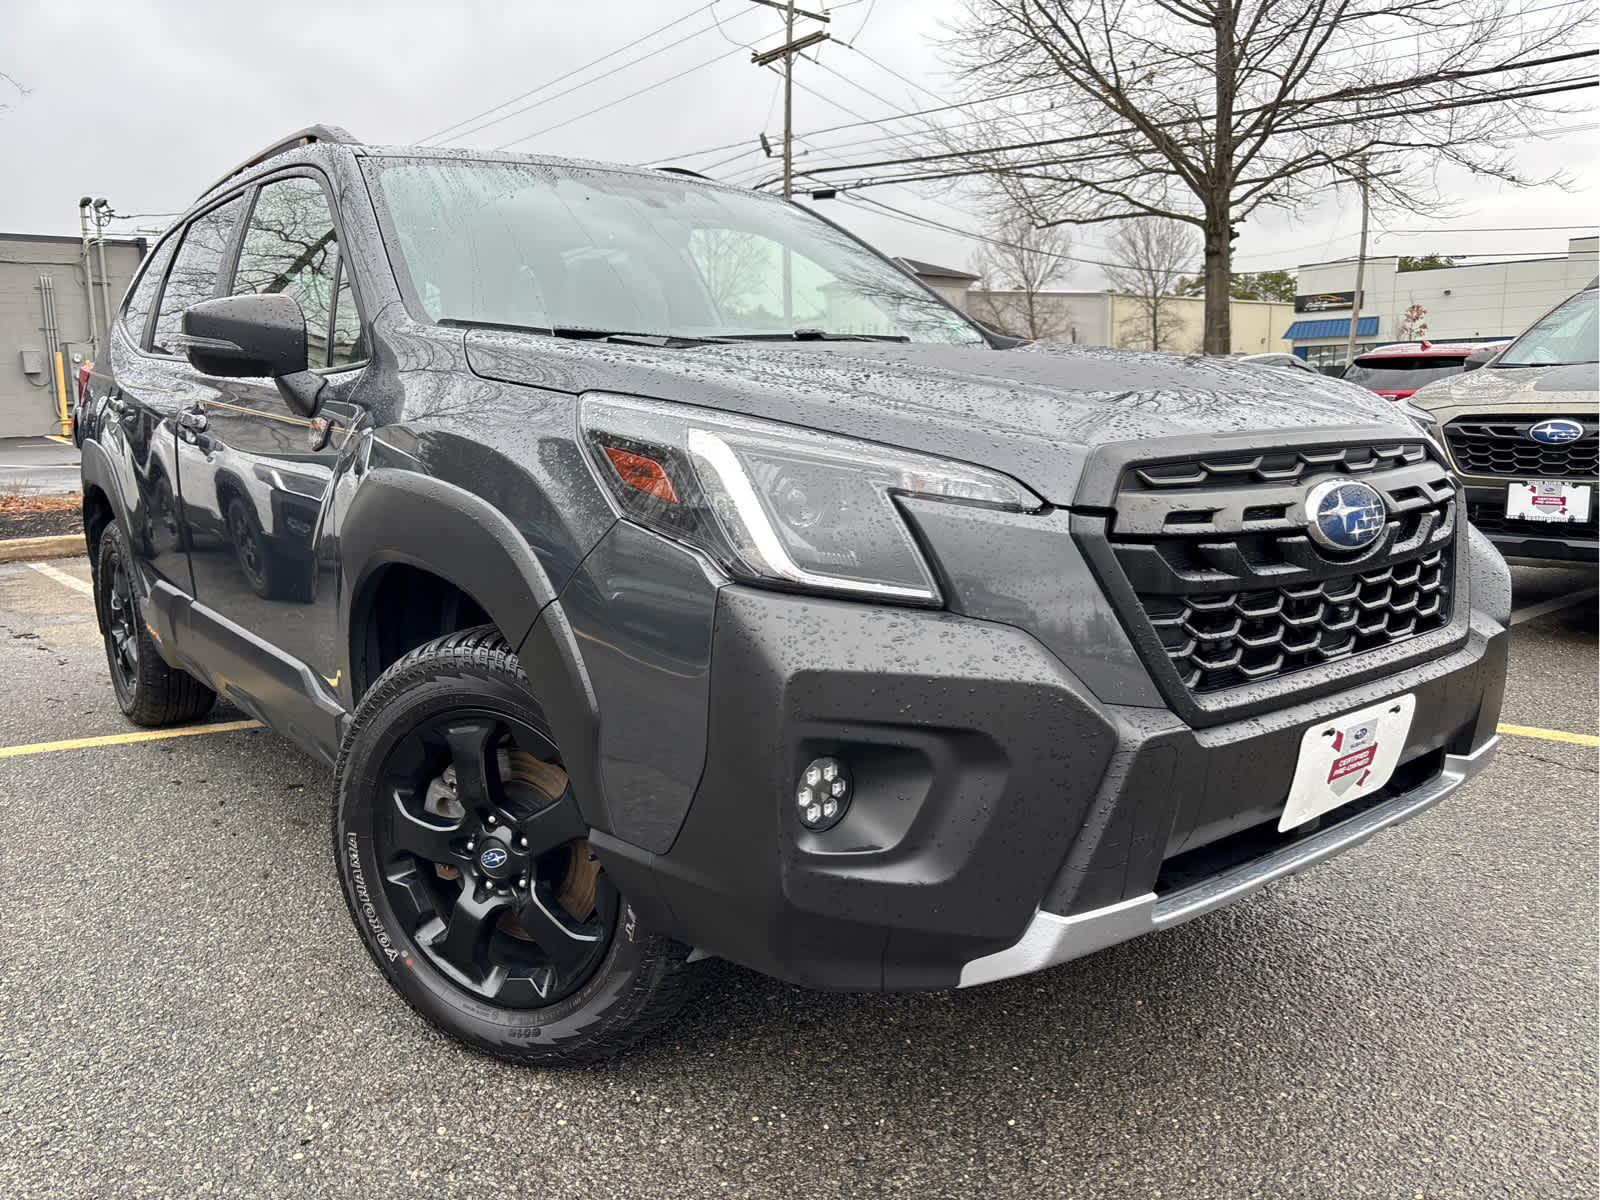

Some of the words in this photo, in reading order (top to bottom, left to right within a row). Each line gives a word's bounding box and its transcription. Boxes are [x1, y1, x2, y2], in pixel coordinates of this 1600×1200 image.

[1333, 758, 1369, 777] PRE-OWNED
[1338, 751, 1369, 767] CERTIFIED
[347, 831, 400, 962] YOKOHAMA
